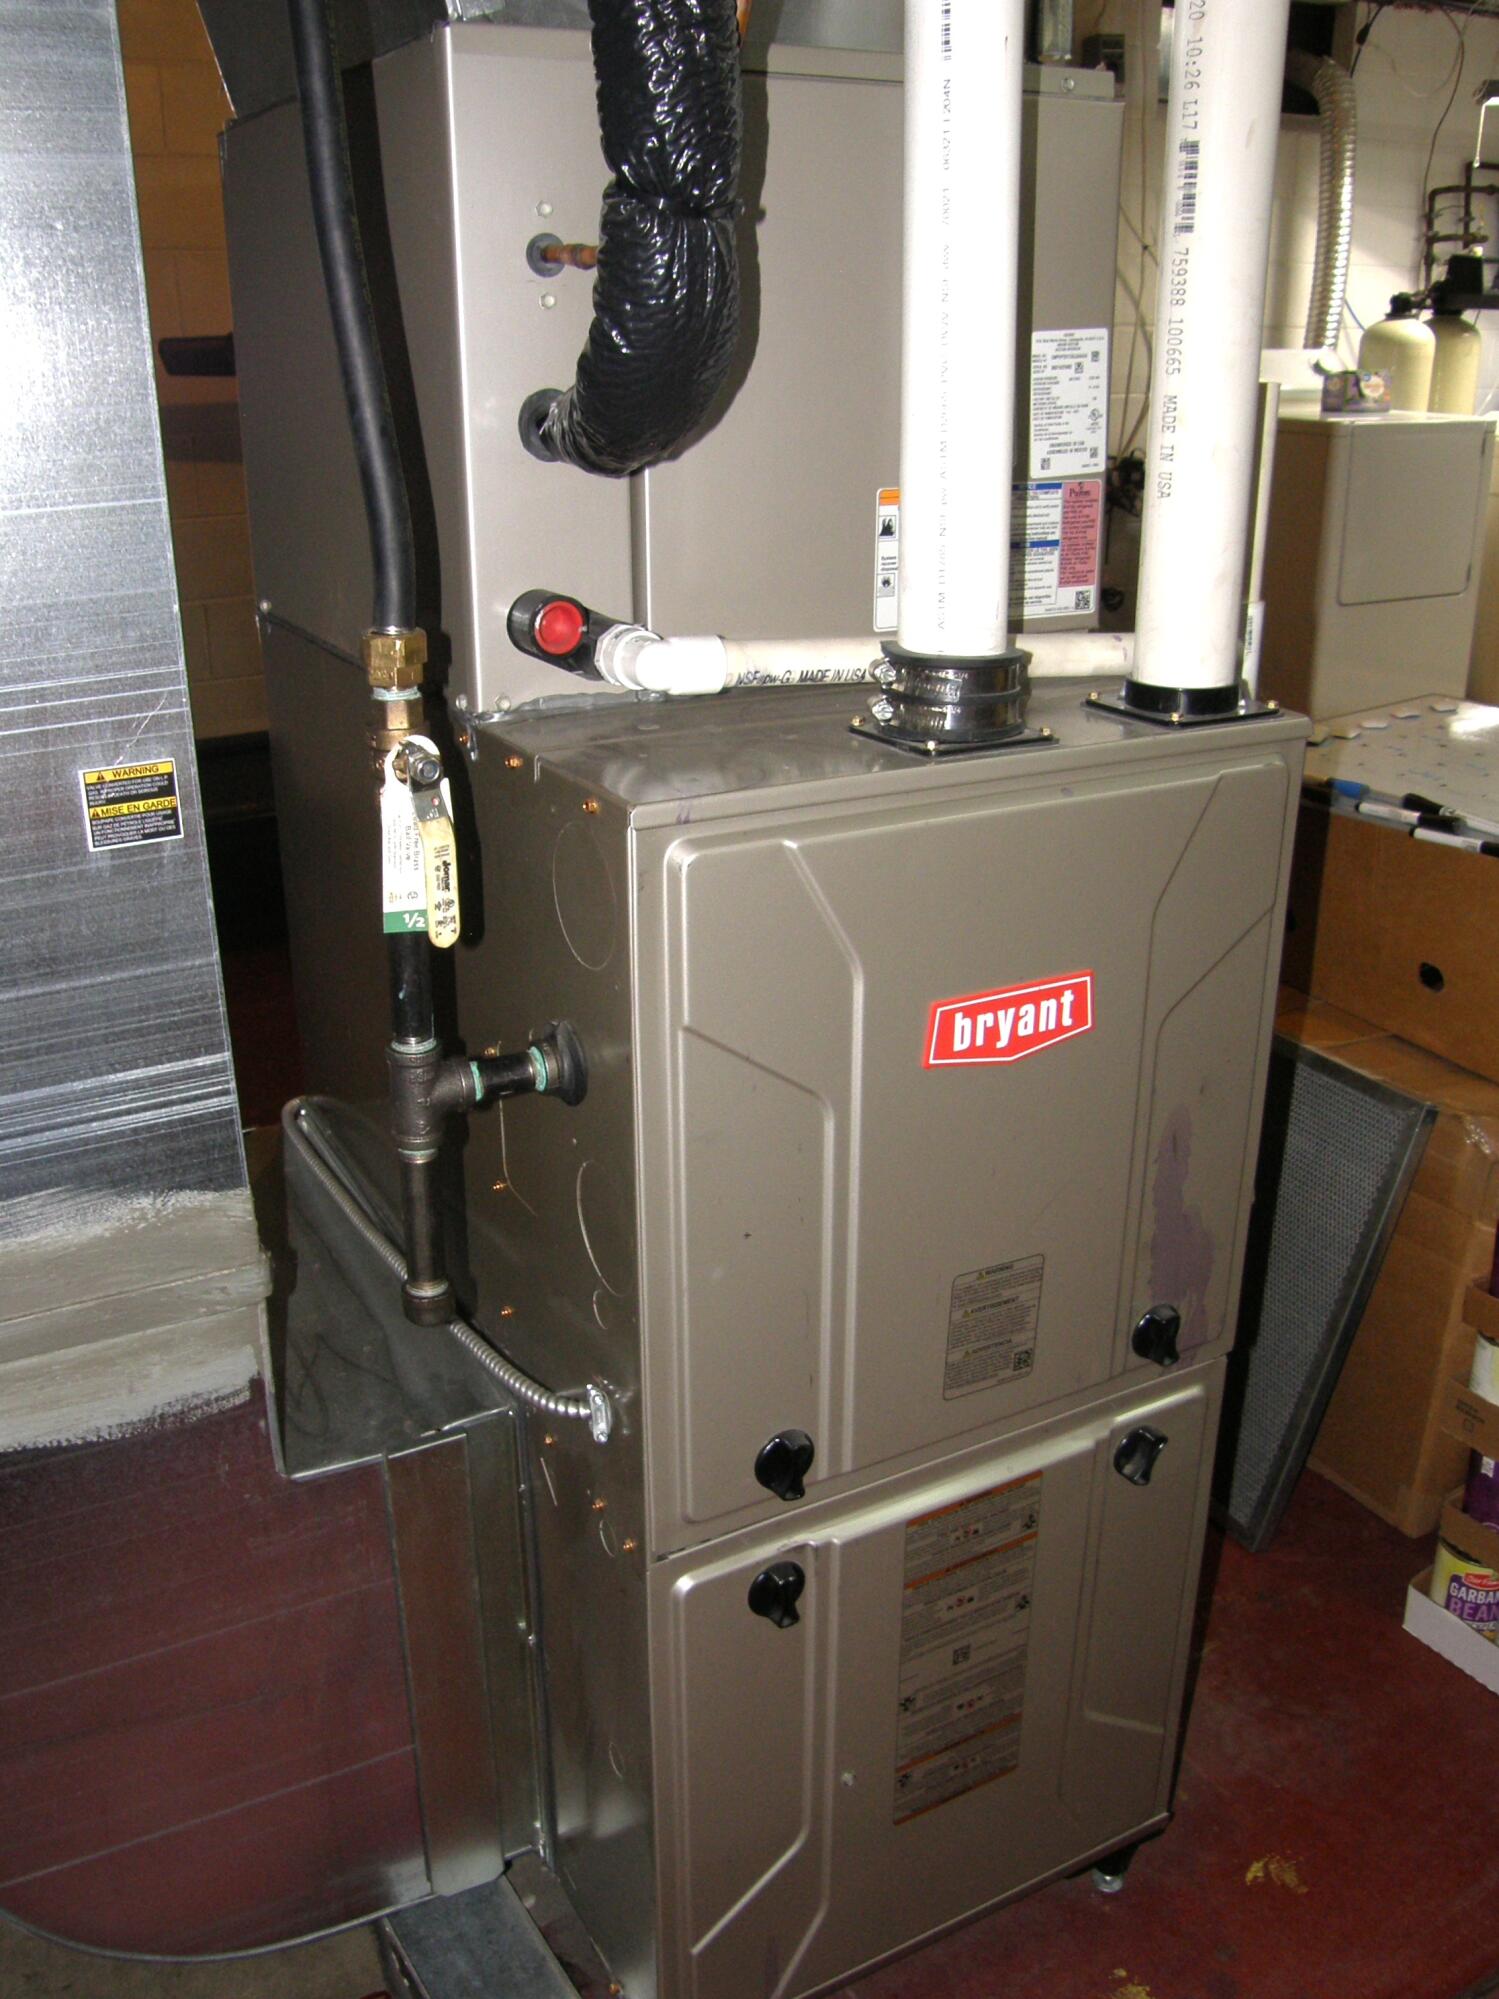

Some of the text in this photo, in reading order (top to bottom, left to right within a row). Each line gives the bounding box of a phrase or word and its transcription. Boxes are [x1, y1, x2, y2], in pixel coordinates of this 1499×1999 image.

[1184, 37, 1203, 90] 10:26
[1182, 99, 1198, 129] L17
[1166, 248, 1189, 375] 759388 100665
[1157, 395, 1178, 499] MADE IN USA
[796, 668, 867, 683] MADE IN USA
[112, 765, 159, 778] WARNING
[101, 798, 177, 817] MISE EN GARDE
[403, 912, 425, 928] 1/2
[953, 990, 1074, 1052] bryant
